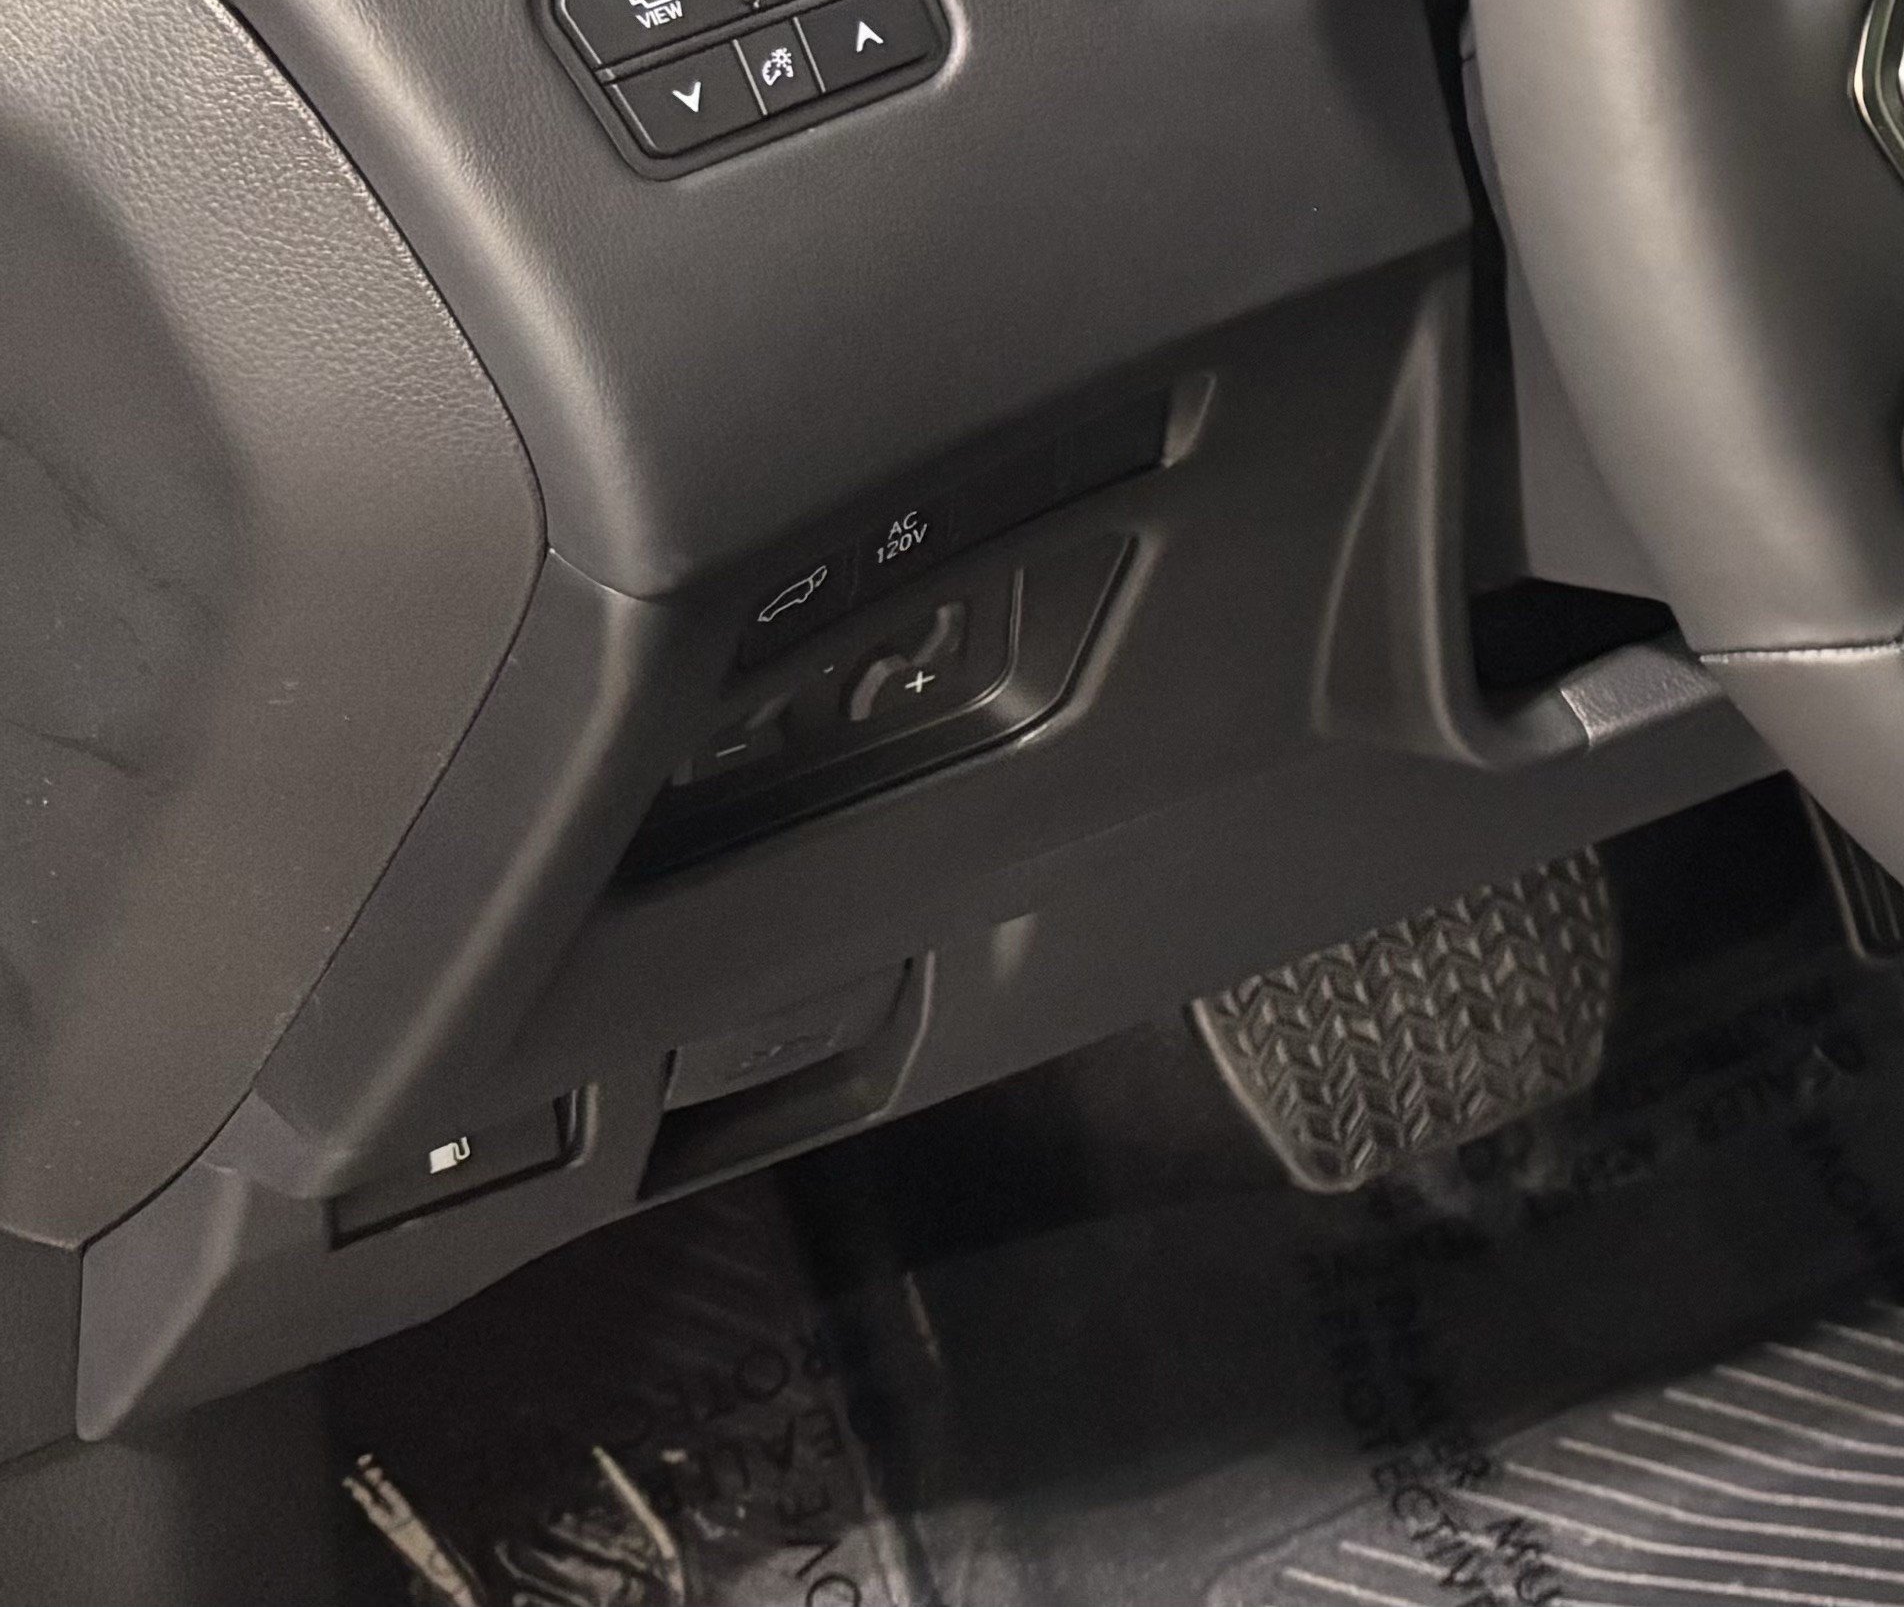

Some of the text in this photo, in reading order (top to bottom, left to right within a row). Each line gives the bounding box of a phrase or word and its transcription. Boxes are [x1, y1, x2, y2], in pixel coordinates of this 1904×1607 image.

[634, 0, 684, 30] VIEW
[887, 510, 919, 540] AC
[876, 523, 929, 564] 120V
